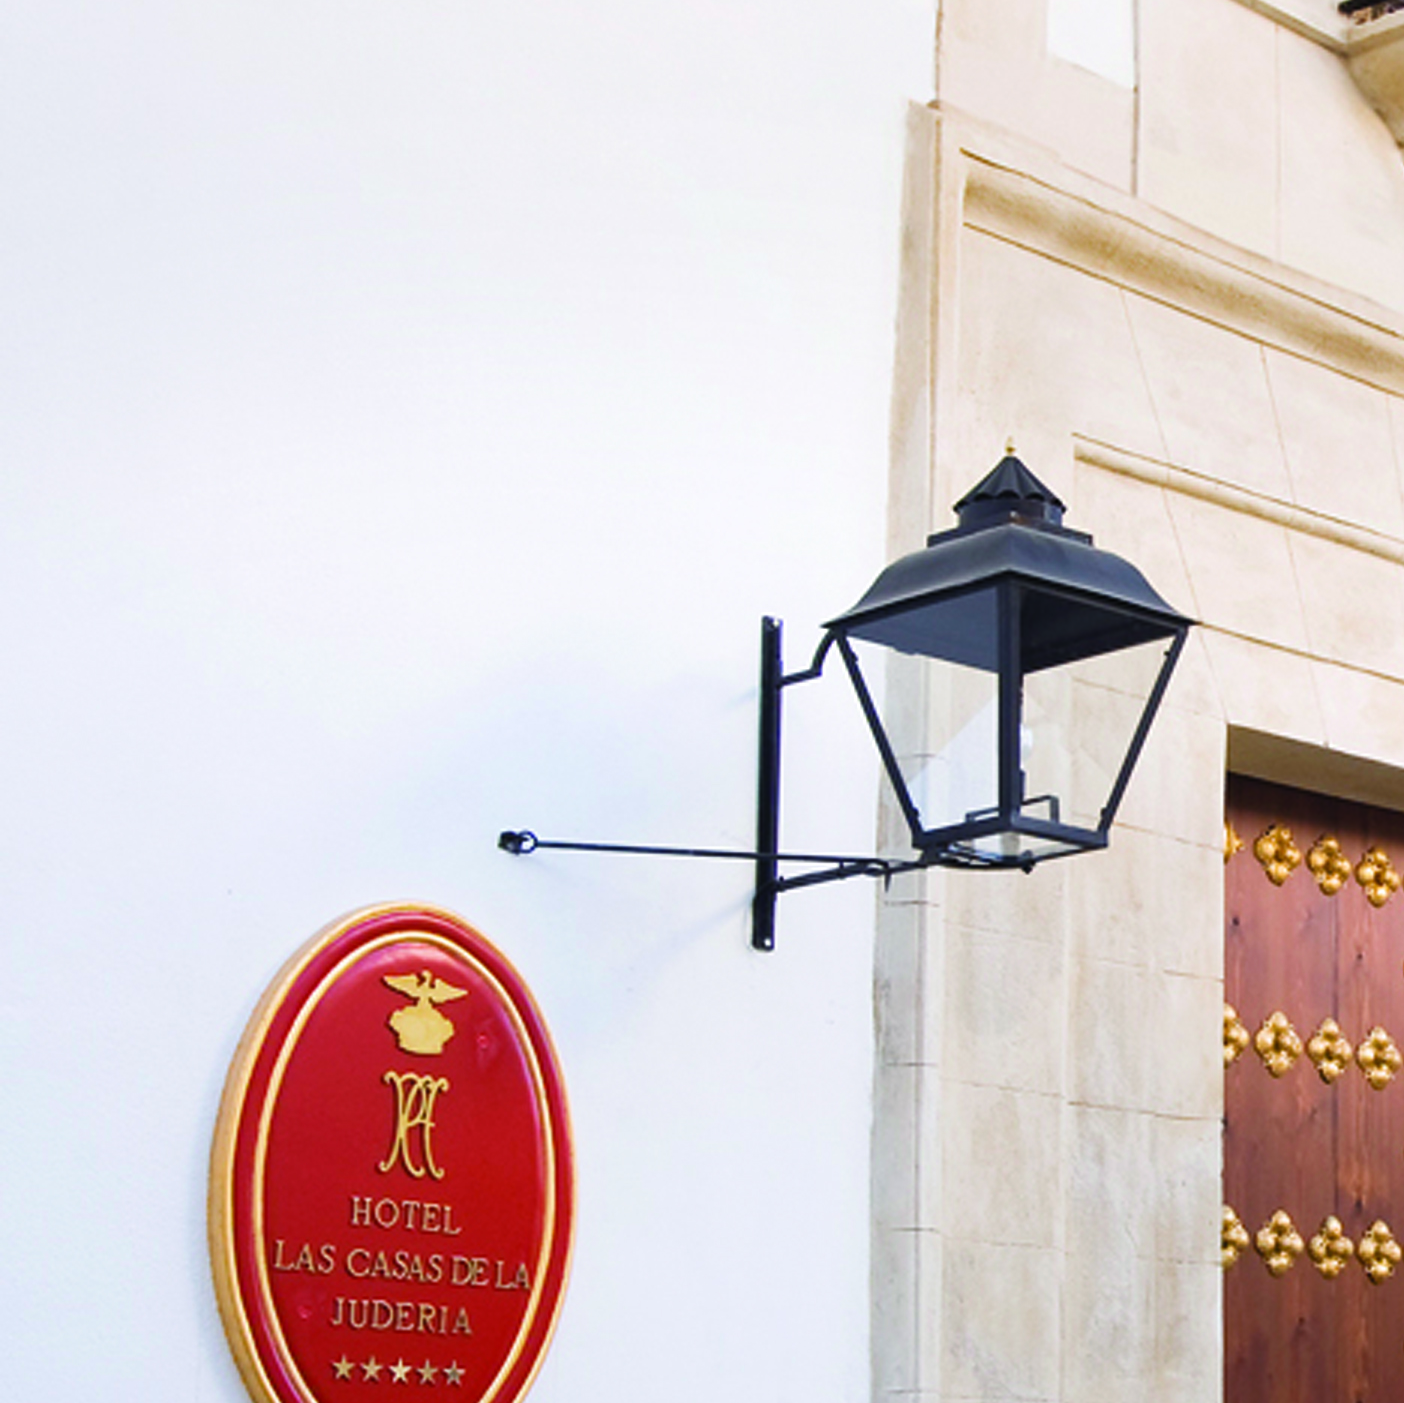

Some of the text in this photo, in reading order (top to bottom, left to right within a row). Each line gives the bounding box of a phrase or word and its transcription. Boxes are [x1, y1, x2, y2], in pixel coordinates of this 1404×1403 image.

[350, 1196, 462, 1235] HOTEL
[273, 1238, 531, 1290] LAS CASAS DE LA
[331, 1296, 473, 1335] JUDERIA
